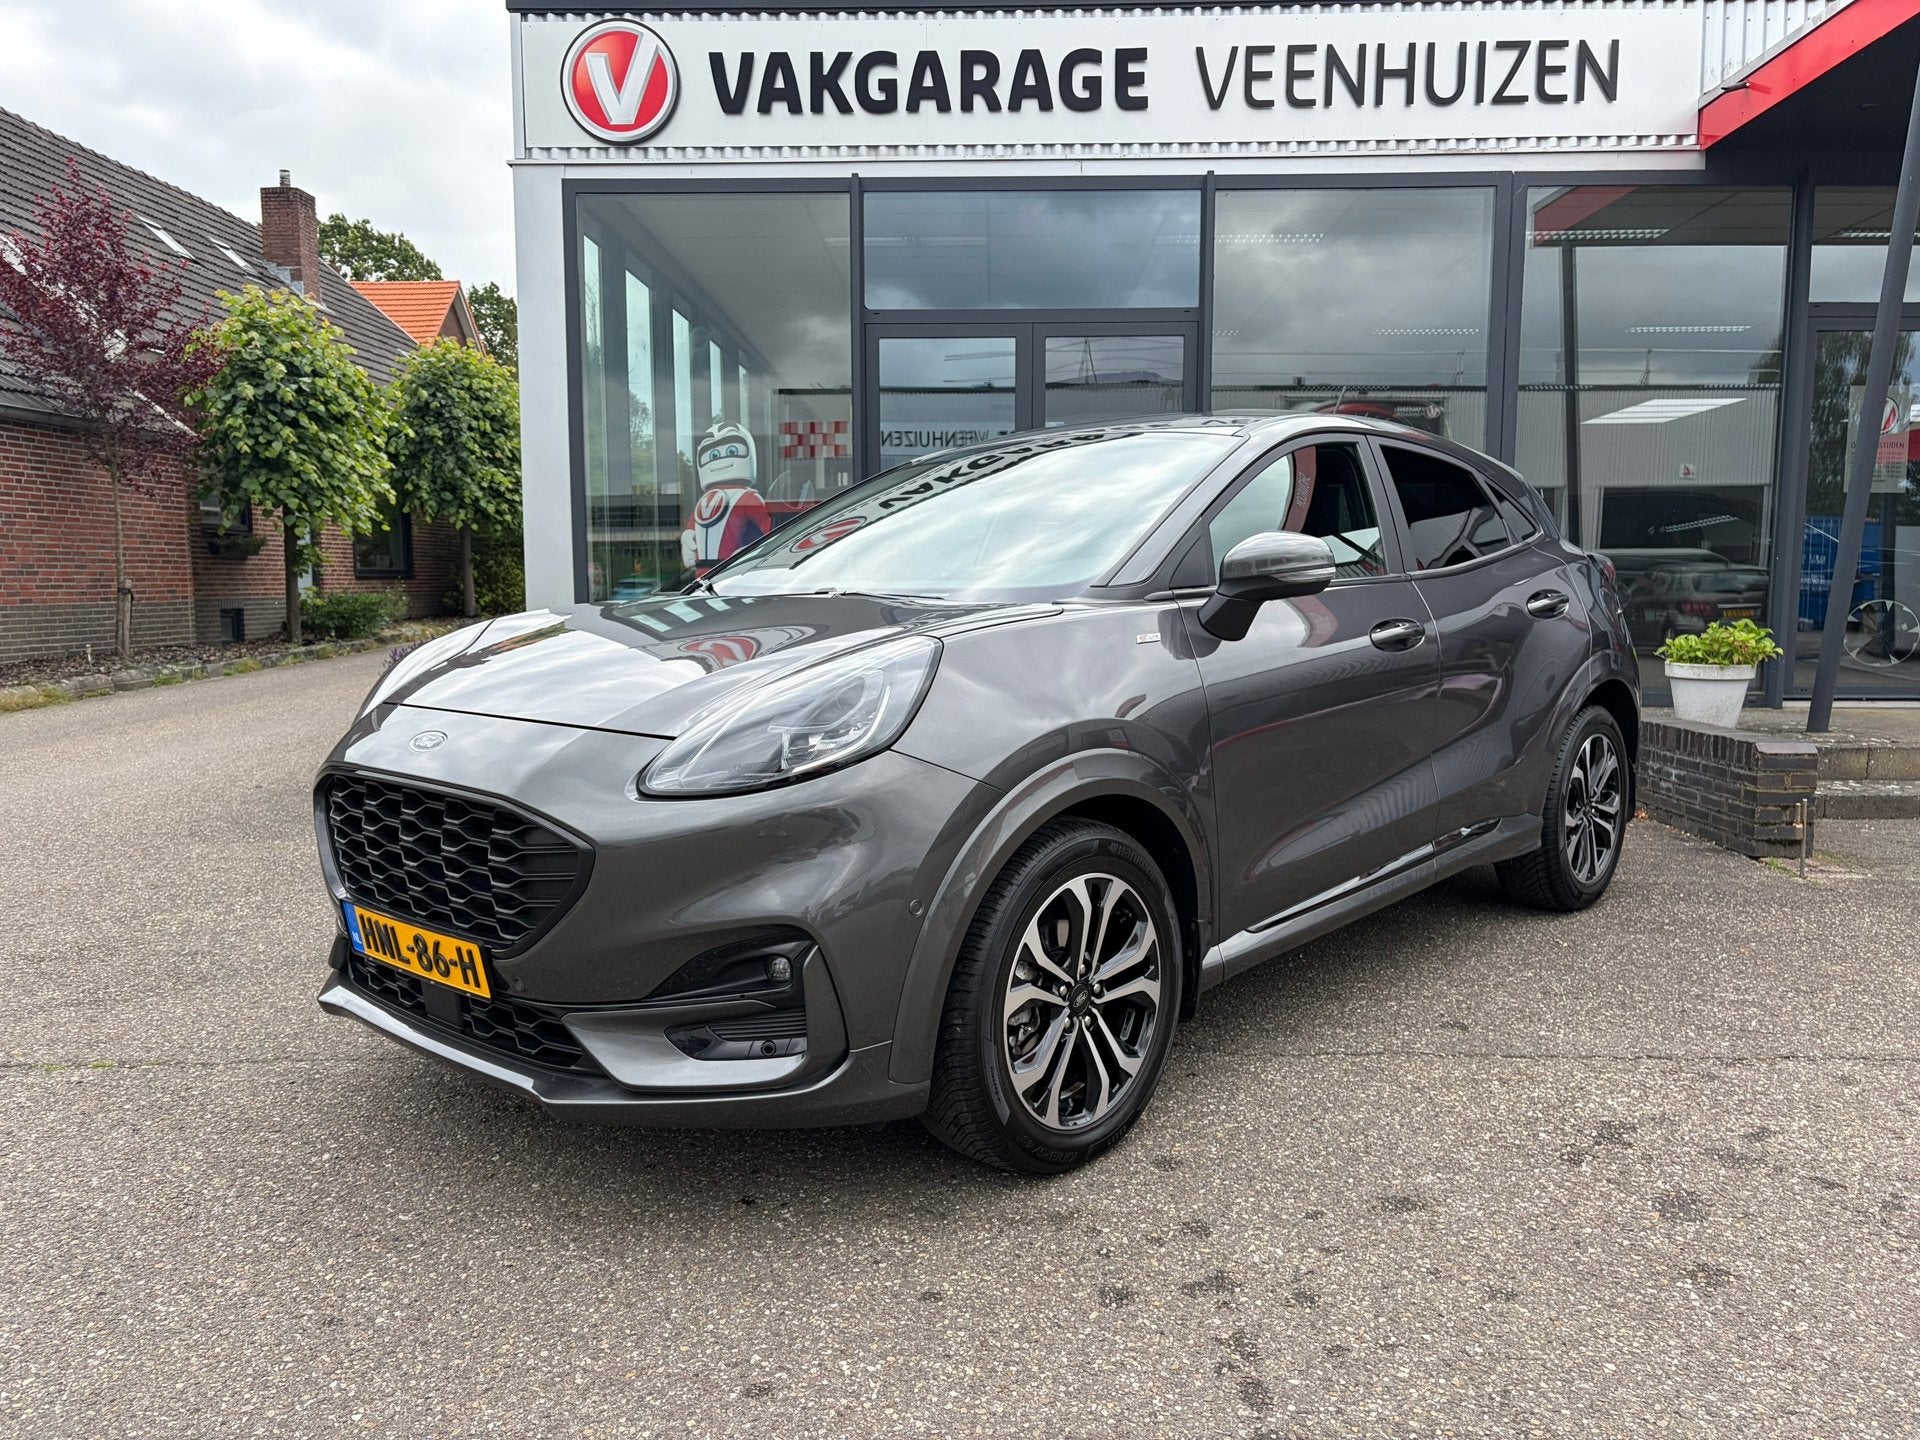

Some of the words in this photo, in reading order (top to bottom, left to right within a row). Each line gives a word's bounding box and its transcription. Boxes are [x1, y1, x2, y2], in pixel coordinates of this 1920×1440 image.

[708, 47, 1149, 114] VAKGARAGE
[1195, 39, 1621, 110] VEENHUIZEN
[352, 930, 362, 944] NL
[358, 913, 481, 989] HNL-86-H
